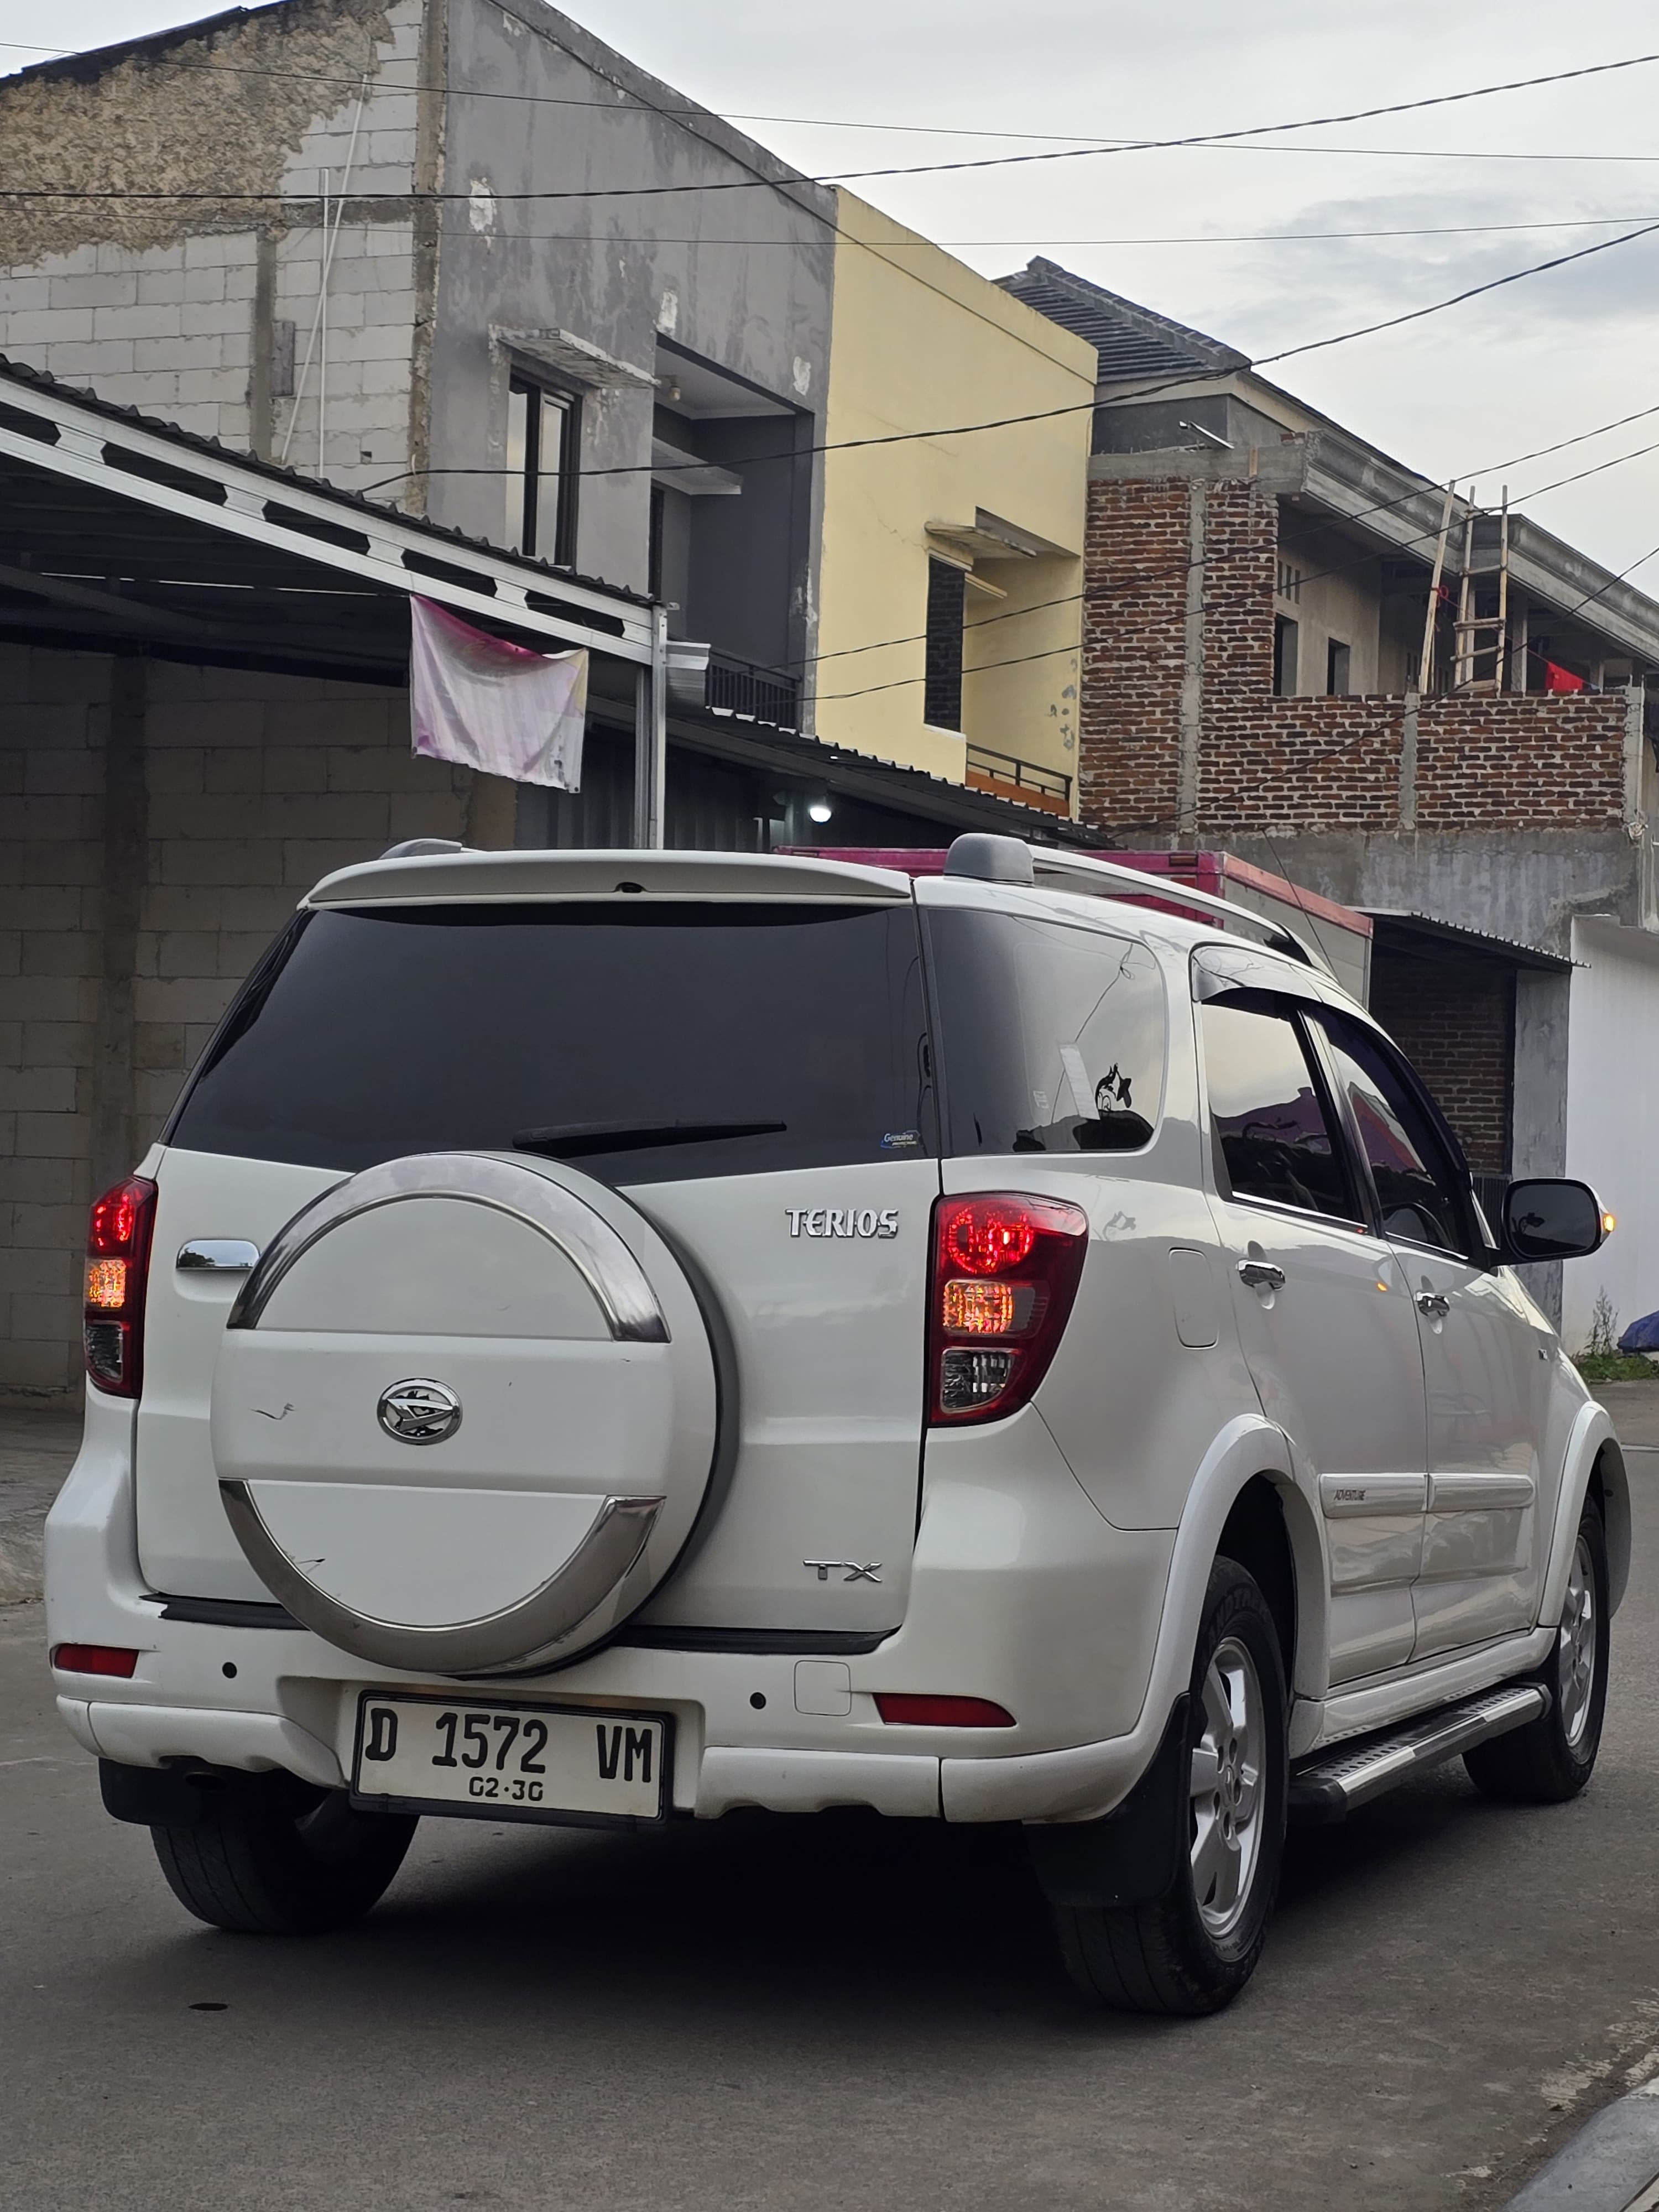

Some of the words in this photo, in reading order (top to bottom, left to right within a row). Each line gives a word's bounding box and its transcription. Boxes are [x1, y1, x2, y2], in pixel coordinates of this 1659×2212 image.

[785, 1208, 899, 1239] TERIOS
[803, 1558, 883, 1583] TX
[365, 1707, 398, 1761] D
[431, 1712, 549, 1774] 1572
[596, 1724, 653, 1783] VM
